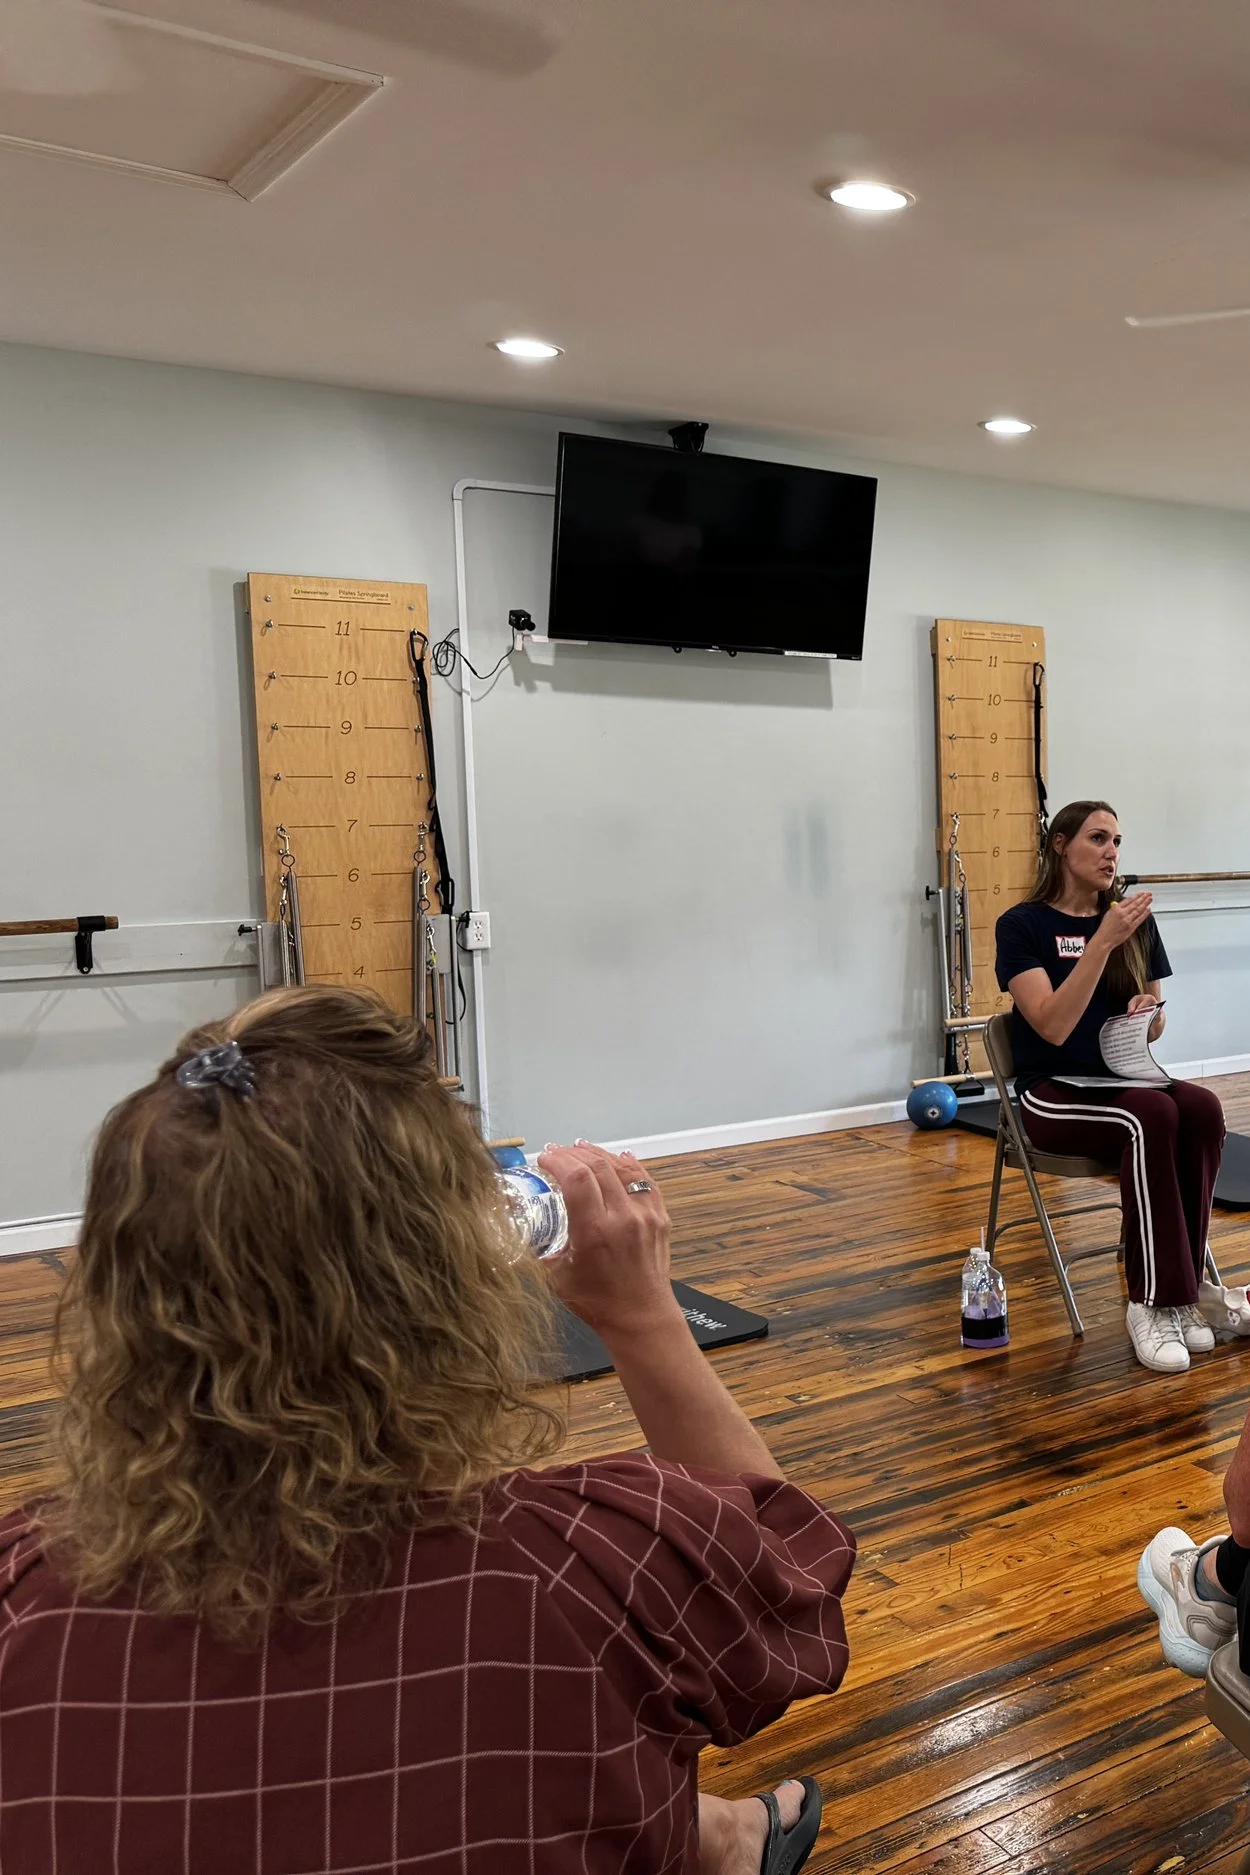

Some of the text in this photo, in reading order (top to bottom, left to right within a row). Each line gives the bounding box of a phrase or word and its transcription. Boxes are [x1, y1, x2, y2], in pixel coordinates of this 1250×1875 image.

[335, 621, 351, 636] 11
[988, 655, 998, 668] 11
[335, 671, 358, 686] 10
[987, 694, 1002, 706] 10
[341, 720, 353, 735] 9
[990, 732, 998, 744] 9
[344, 771, 356, 785] 8
[992, 771, 1000, 783] 8
[992, 809, 1000, 820] 7
[347, 819, 359, 832] 7
[992, 846, 1001, 858] 6
[348, 867, 360, 882] 6
[993, 884, 1001, 896] 5
[350, 917, 362, 931] 5
[353, 965, 365, 979] 4
[995, 996, 1003, 1007] 2
[682, 1308, 728, 1330] ithew
